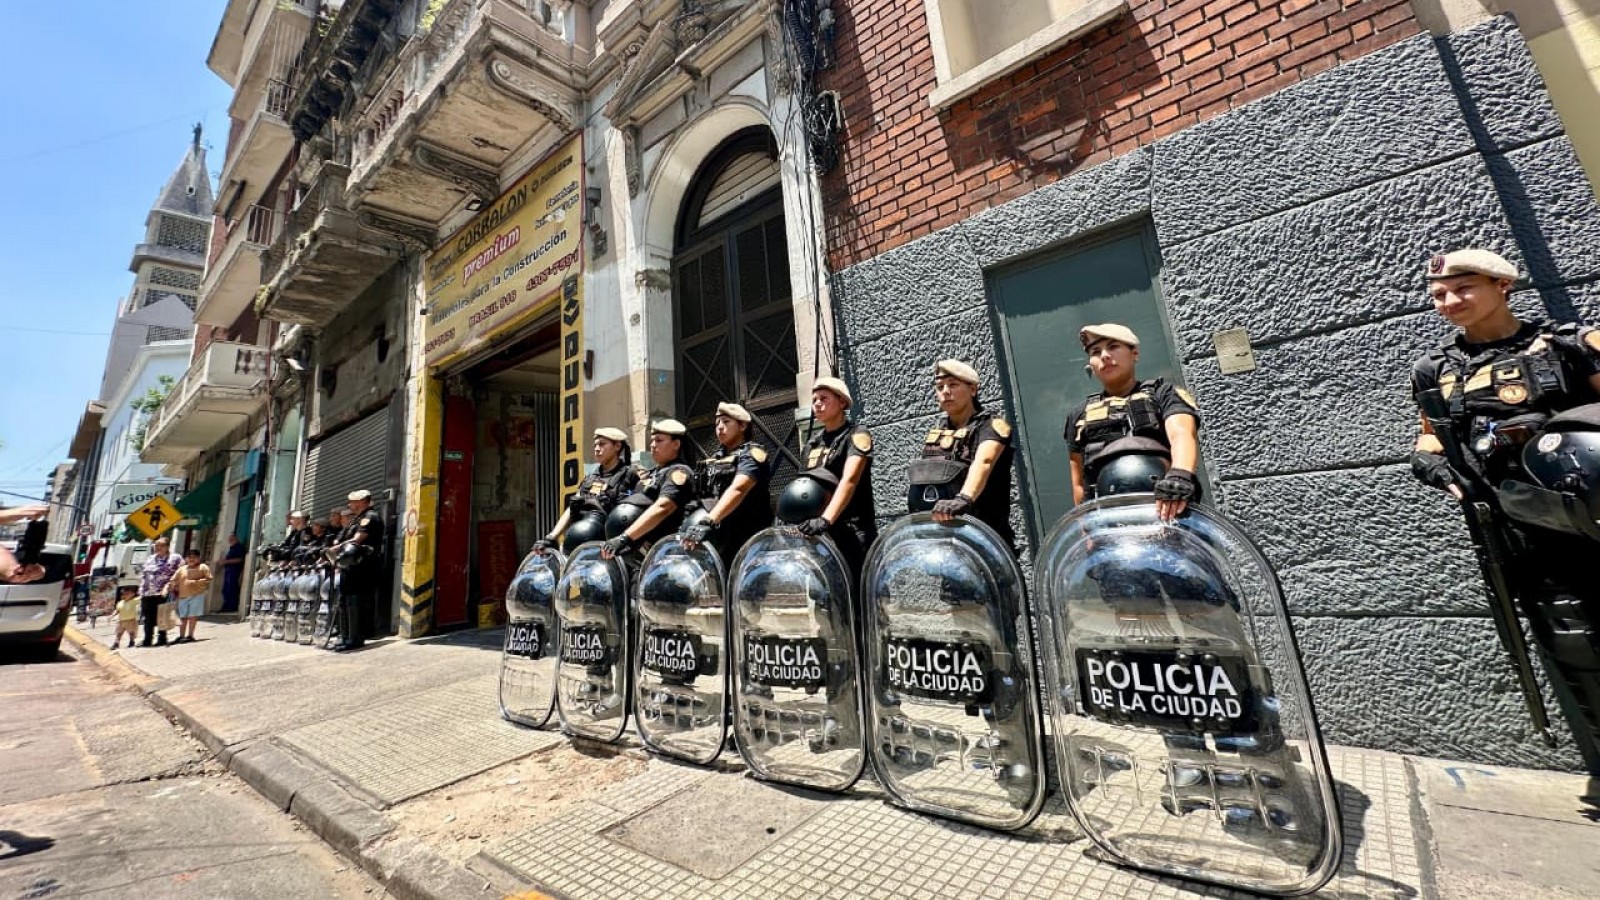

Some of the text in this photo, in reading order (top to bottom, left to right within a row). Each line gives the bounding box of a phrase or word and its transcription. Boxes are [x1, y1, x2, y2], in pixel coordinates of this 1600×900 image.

[463, 225, 521, 287] premium
[115, 485, 175, 510] Kiosco
[657, 657, 696, 671] CIUDAD
[748, 642, 820, 666] POLICIA
[888, 643, 983, 676] POLICIA
[772, 666, 822, 680] CIUDAD
[888, 668, 985, 694] DE LA CIUDAD
[1086, 657, 1238, 696] POLICIA
[1091, 685, 1242, 719] DE LA CIUDAD
